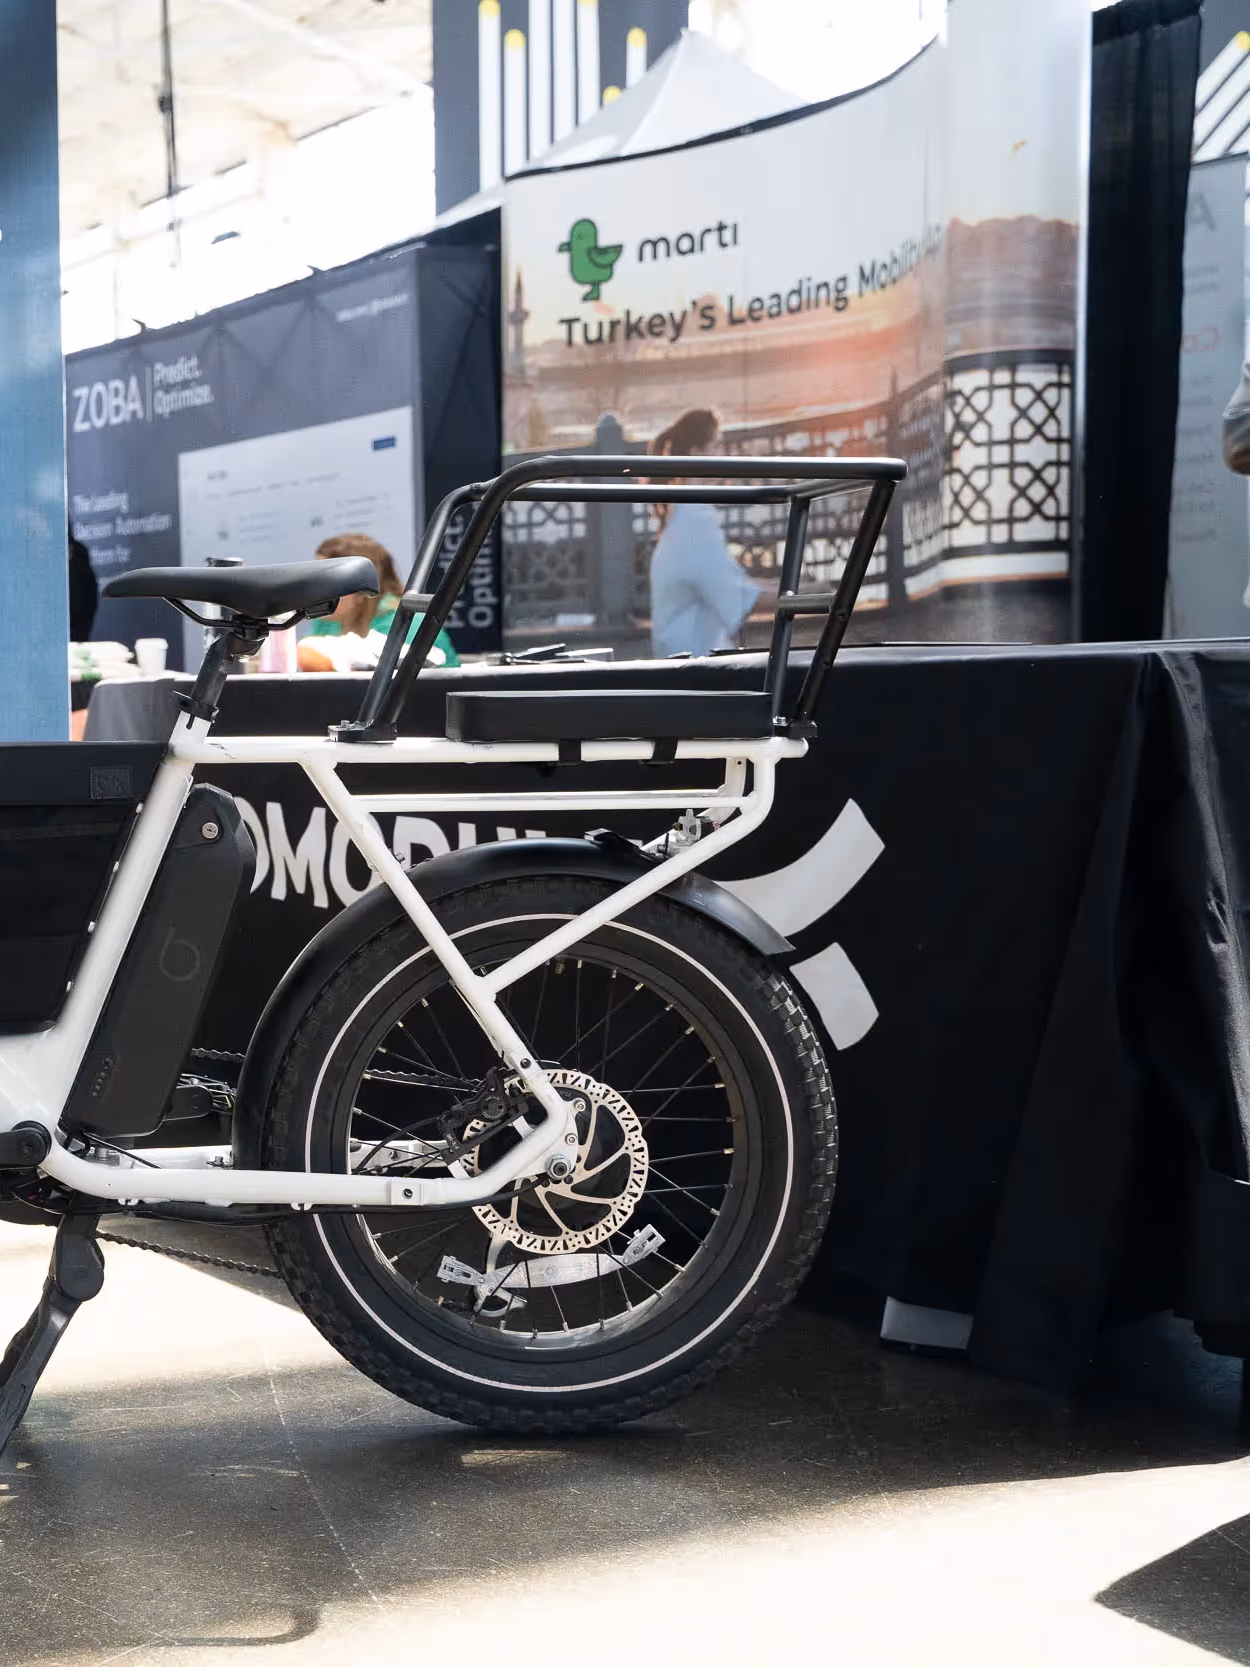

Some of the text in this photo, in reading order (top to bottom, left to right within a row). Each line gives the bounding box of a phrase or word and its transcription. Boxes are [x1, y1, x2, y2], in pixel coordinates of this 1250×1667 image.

[558, 300, 716, 348] Turkey's
[727, 275, 849, 327] Leading
[72, 374, 144, 433] ZOBA
